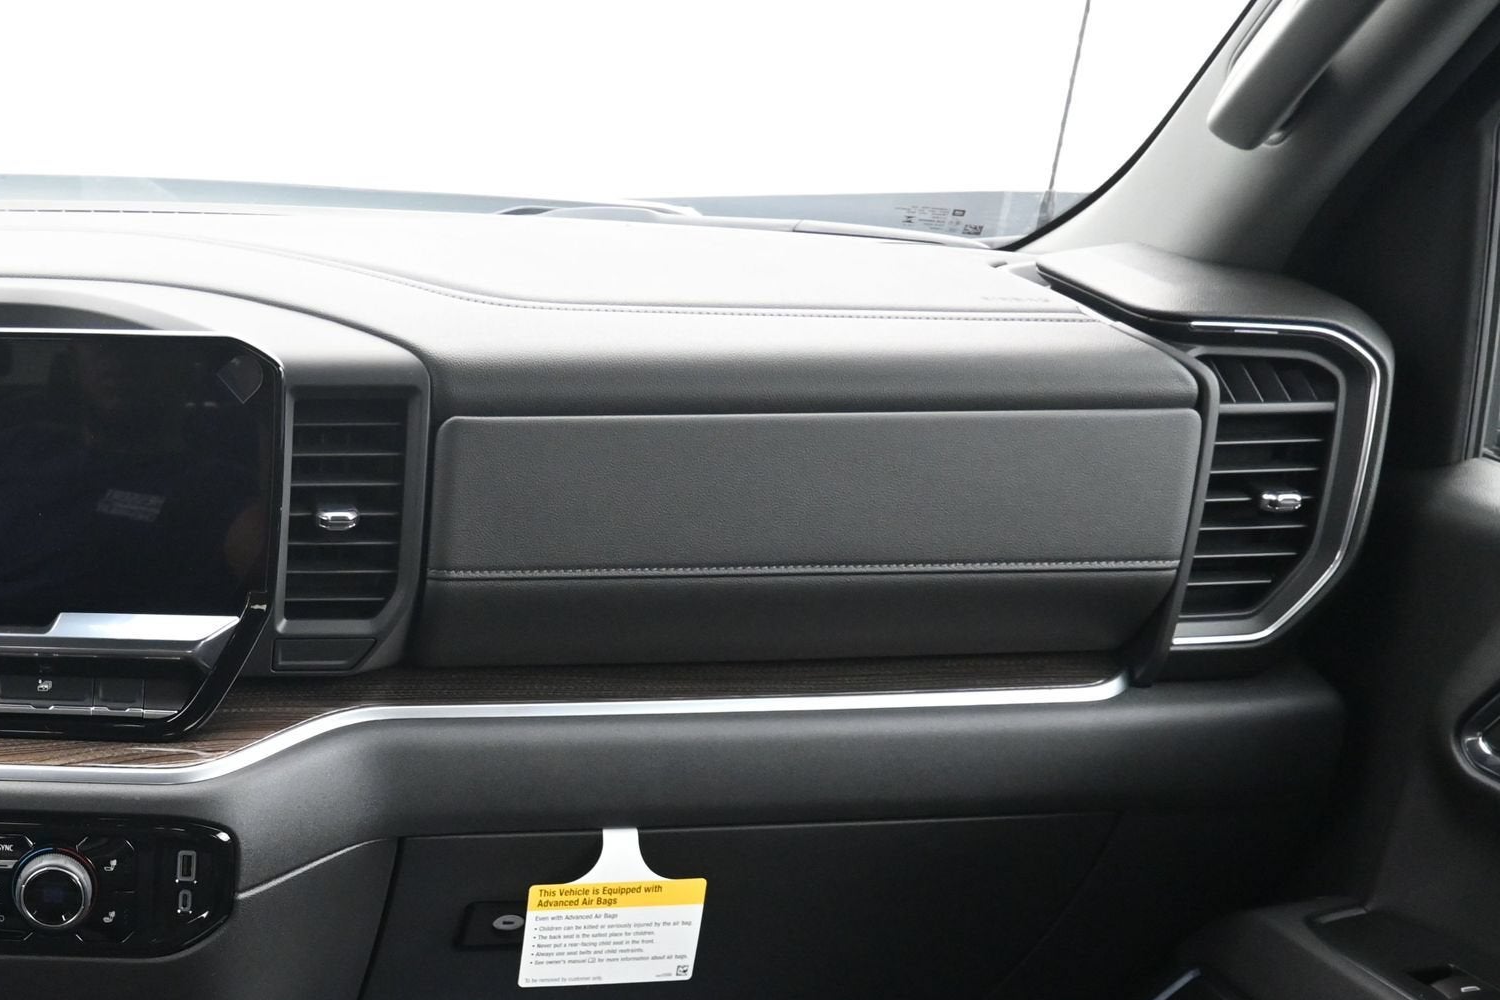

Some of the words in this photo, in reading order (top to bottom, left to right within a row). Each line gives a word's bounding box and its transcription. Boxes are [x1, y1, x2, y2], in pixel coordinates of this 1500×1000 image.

[539, 889, 556, 897] This
[560, 887, 590, 897] Vehicle
[592, 887, 600, 895] is
[602, 885, 641, 896] Equipped
[644, 885, 663, 893] with
[537, 898, 579, 908] Advanced
[581, 897, 594, 906] Air
[596, 897, 618, 906] Bags
